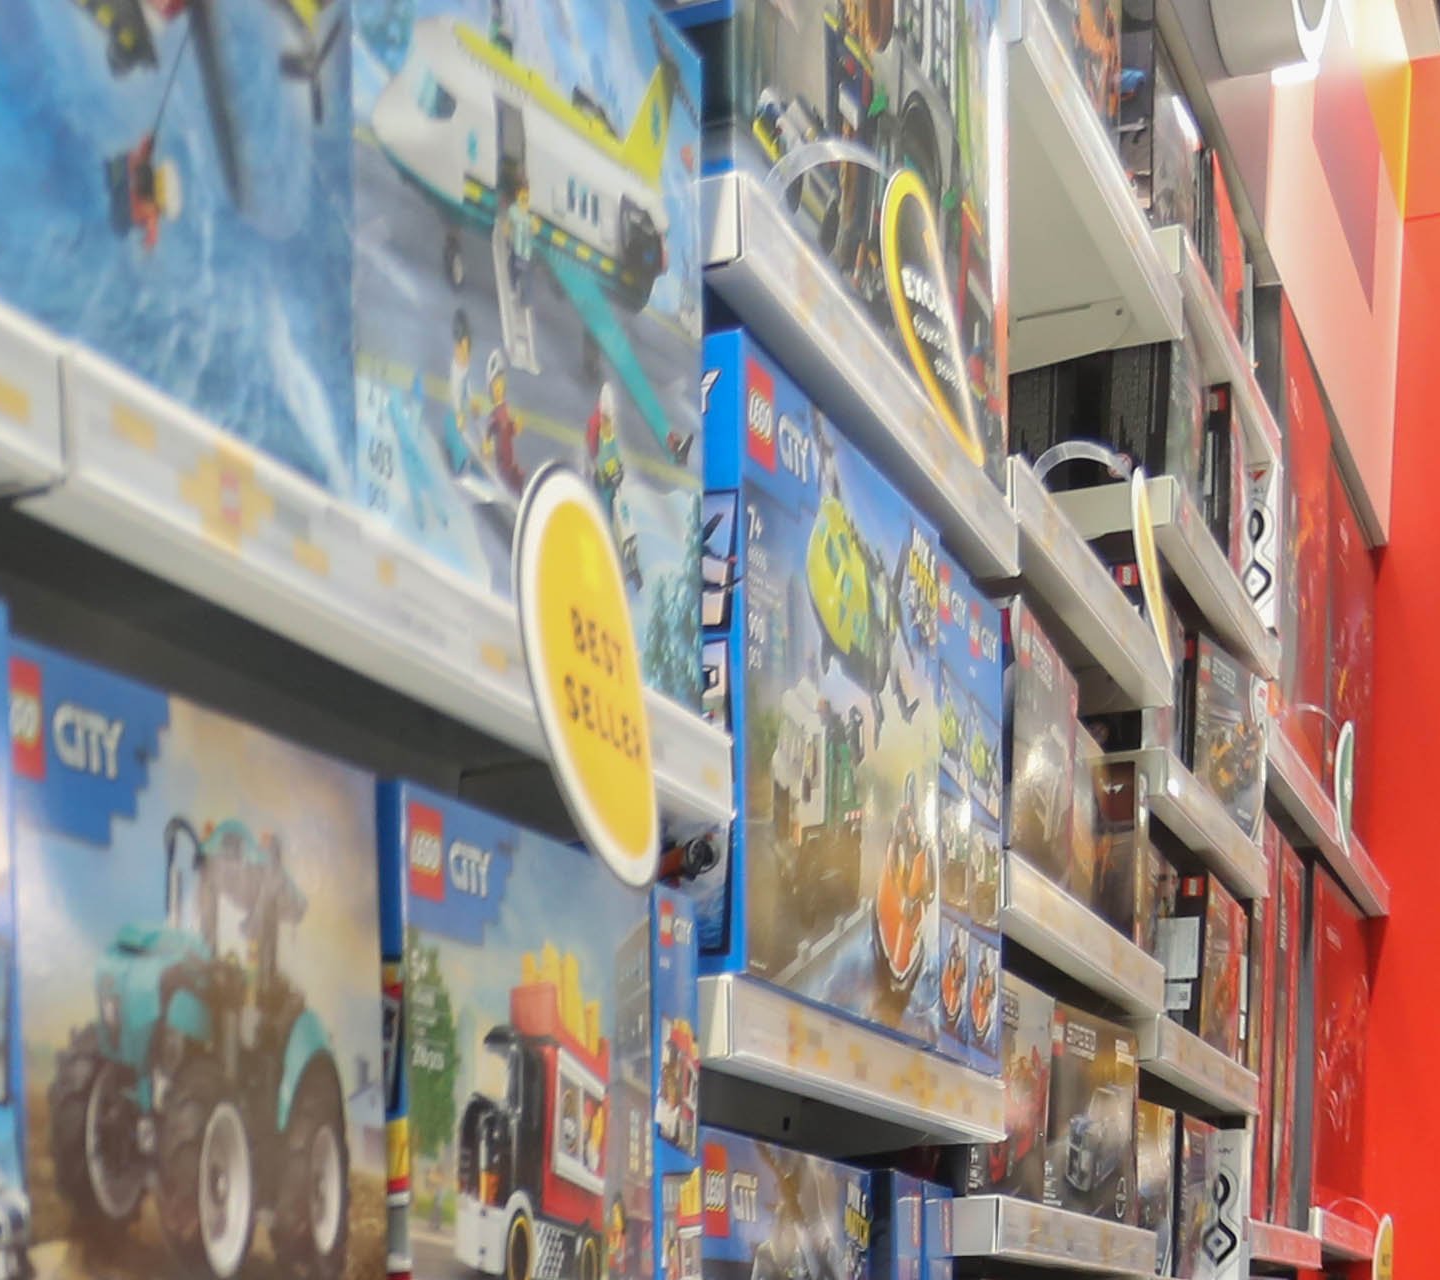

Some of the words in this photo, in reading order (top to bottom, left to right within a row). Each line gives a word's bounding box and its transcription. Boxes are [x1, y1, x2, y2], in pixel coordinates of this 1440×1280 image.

[748, 387, 772, 445] LEGO
[778, 414, 809, 484] CITY
[747, 504, 763, 540] 7+
[571, 608, 623, 684] BEST
[10, 691, 41, 745] GO
[53, 703, 124, 779] CITY
[565, 675, 643, 760] SELLER
[410, 831, 442, 877] LEGO
[449, 838, 491, 898] CITY
[707, 1170, 726, 1212] LEGO
[731, 1171, 758, 1222] CITY
